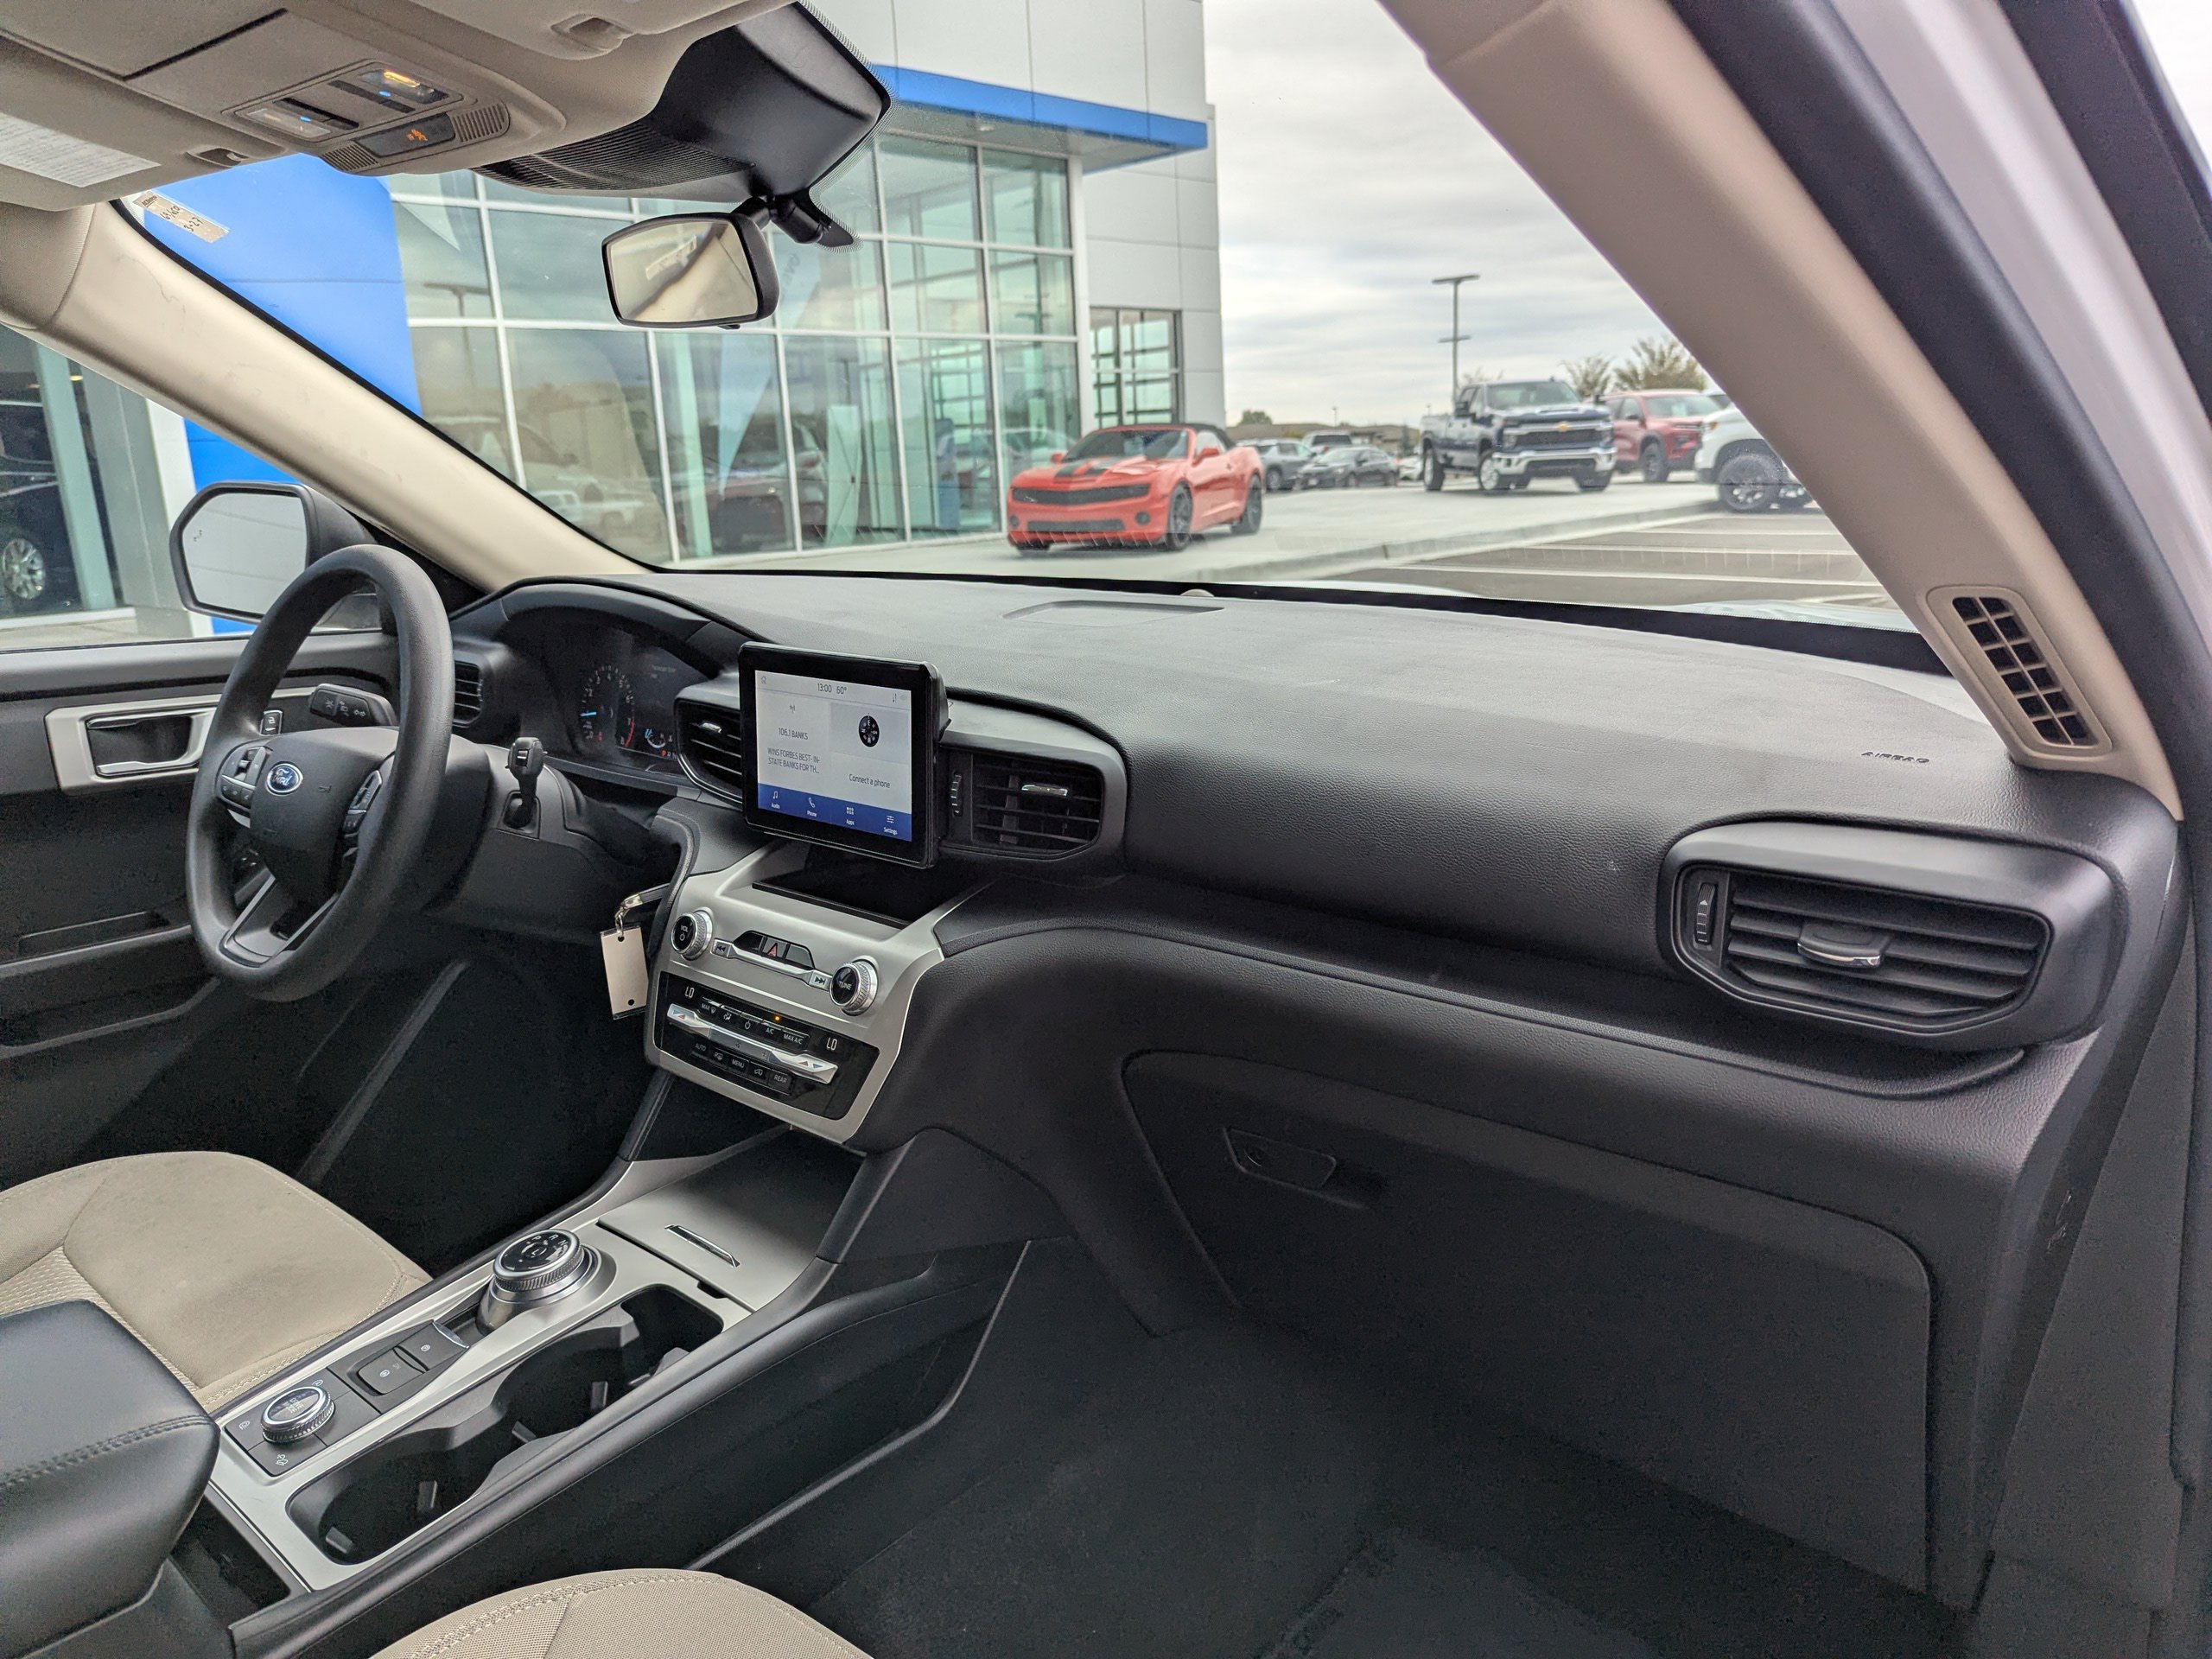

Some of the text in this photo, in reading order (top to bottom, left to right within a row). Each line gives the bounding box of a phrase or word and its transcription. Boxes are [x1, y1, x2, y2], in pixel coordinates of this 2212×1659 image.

[817, 683, 832, 693] 13:00
[778, 727, 809, 741] 106.1 BANKS
[767, 747, 780, 756] WINS
[779, 749, 798, 760] FORBES
[768, 757, 783, 766] STATE
[783, 760, 799, 770] BANKS
[798, 762, 810, 772] FOR
[849, 773, 870, 785] Connect
[874, 778, 891, 789] phone
[883, 826, 898, 836] Settings
[679, 925, 690, 933] VOL
[838, 980, 853, 991] TUNE
[684, 986, 695, 999] LO
[766, 1027, 775, 1035] A/C
[783, 1033, 804, 1046] MAX A/C
[826, 1037, 838, 1051] LO
[732, 1058, 745, 1070] MENU
[773, 1073, 788, 1084] REAR
